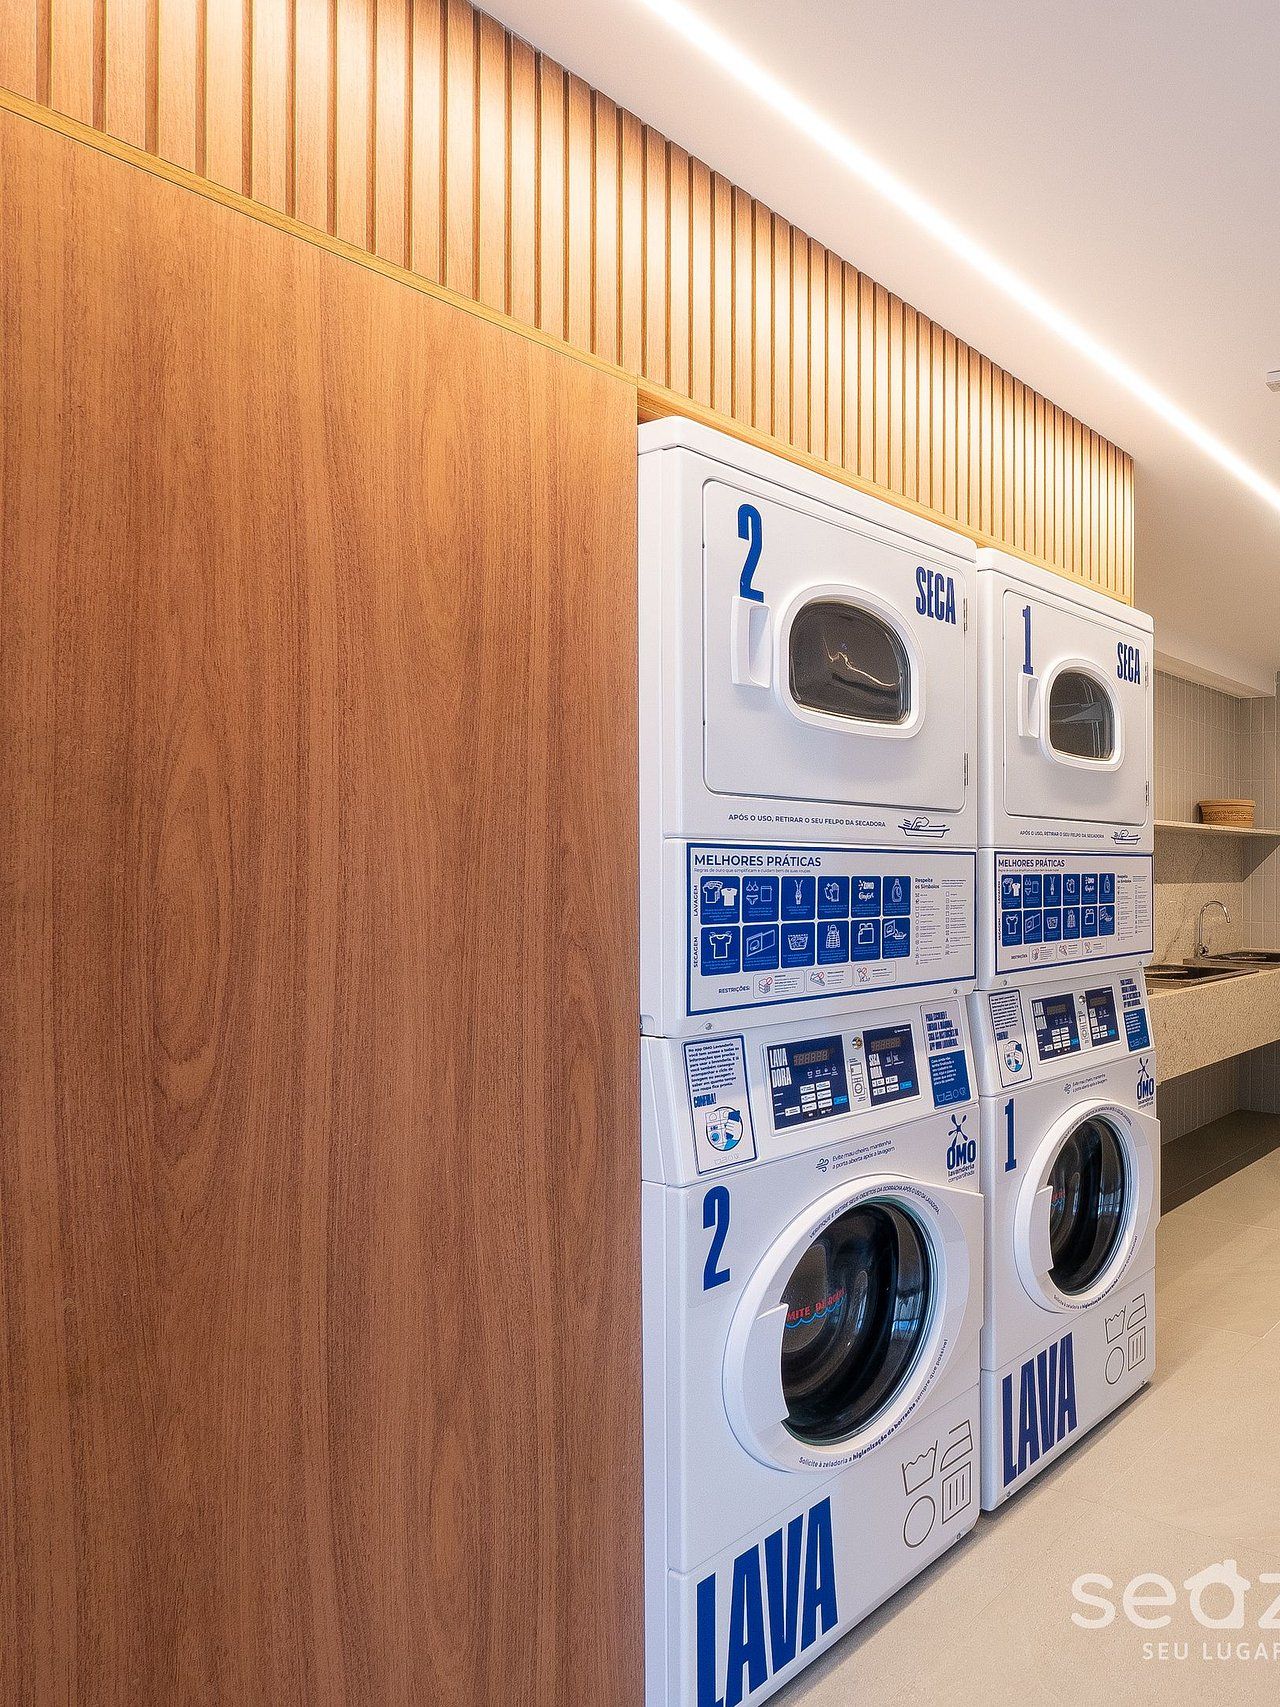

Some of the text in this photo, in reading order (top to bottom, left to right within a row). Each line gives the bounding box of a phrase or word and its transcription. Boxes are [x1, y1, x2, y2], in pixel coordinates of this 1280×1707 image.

[738, 503, 764, 604] 2
[915, 566, 956, 625] SECA
[1022, 605, 1033, 675] 1
[1117, 642, 1140, 684] SECA
[728, 813, 749, 821] APÓS
[757, 815, 774, 823] USO,
[775, 815, 804, 823] RETIRAR
[694, 854, 822, 867] MELHORES PRÁTICAS
[998, 857, 1065, 867] MELHORES PRÁTICAS
[718, 985, 751, 994] RESTRIÇÕES:
[769, 1047, 788, 1068] LAVA
[771, 1066, 792, 1088] DORA
[1136, 1078, 1155, 1100] OMO
[869, 1139, 892, 1150] mantenha
[1005, 1098, 1016, 1172] 1
[947, 1140, 976, 1170] OMO
[948, 1163, 975, 1177] lavanderia
[703, 1185, 730, 1292] 2
[799, 1456, 819, 1468] Solicite
[822, 1457, 848, 1468] zeladoria
[852, 1433, 888, 1461] higienização
[887, 1427, 895, 1436] da
[893, 1402, 916, 1430] borracha
[915, 1379, 931, 1403] sempre
[929, 1366, 937, 1380] que
[1002, 1332, 1078, 1488] LAVA
[697, 1495, 838, 1707] LAVA
